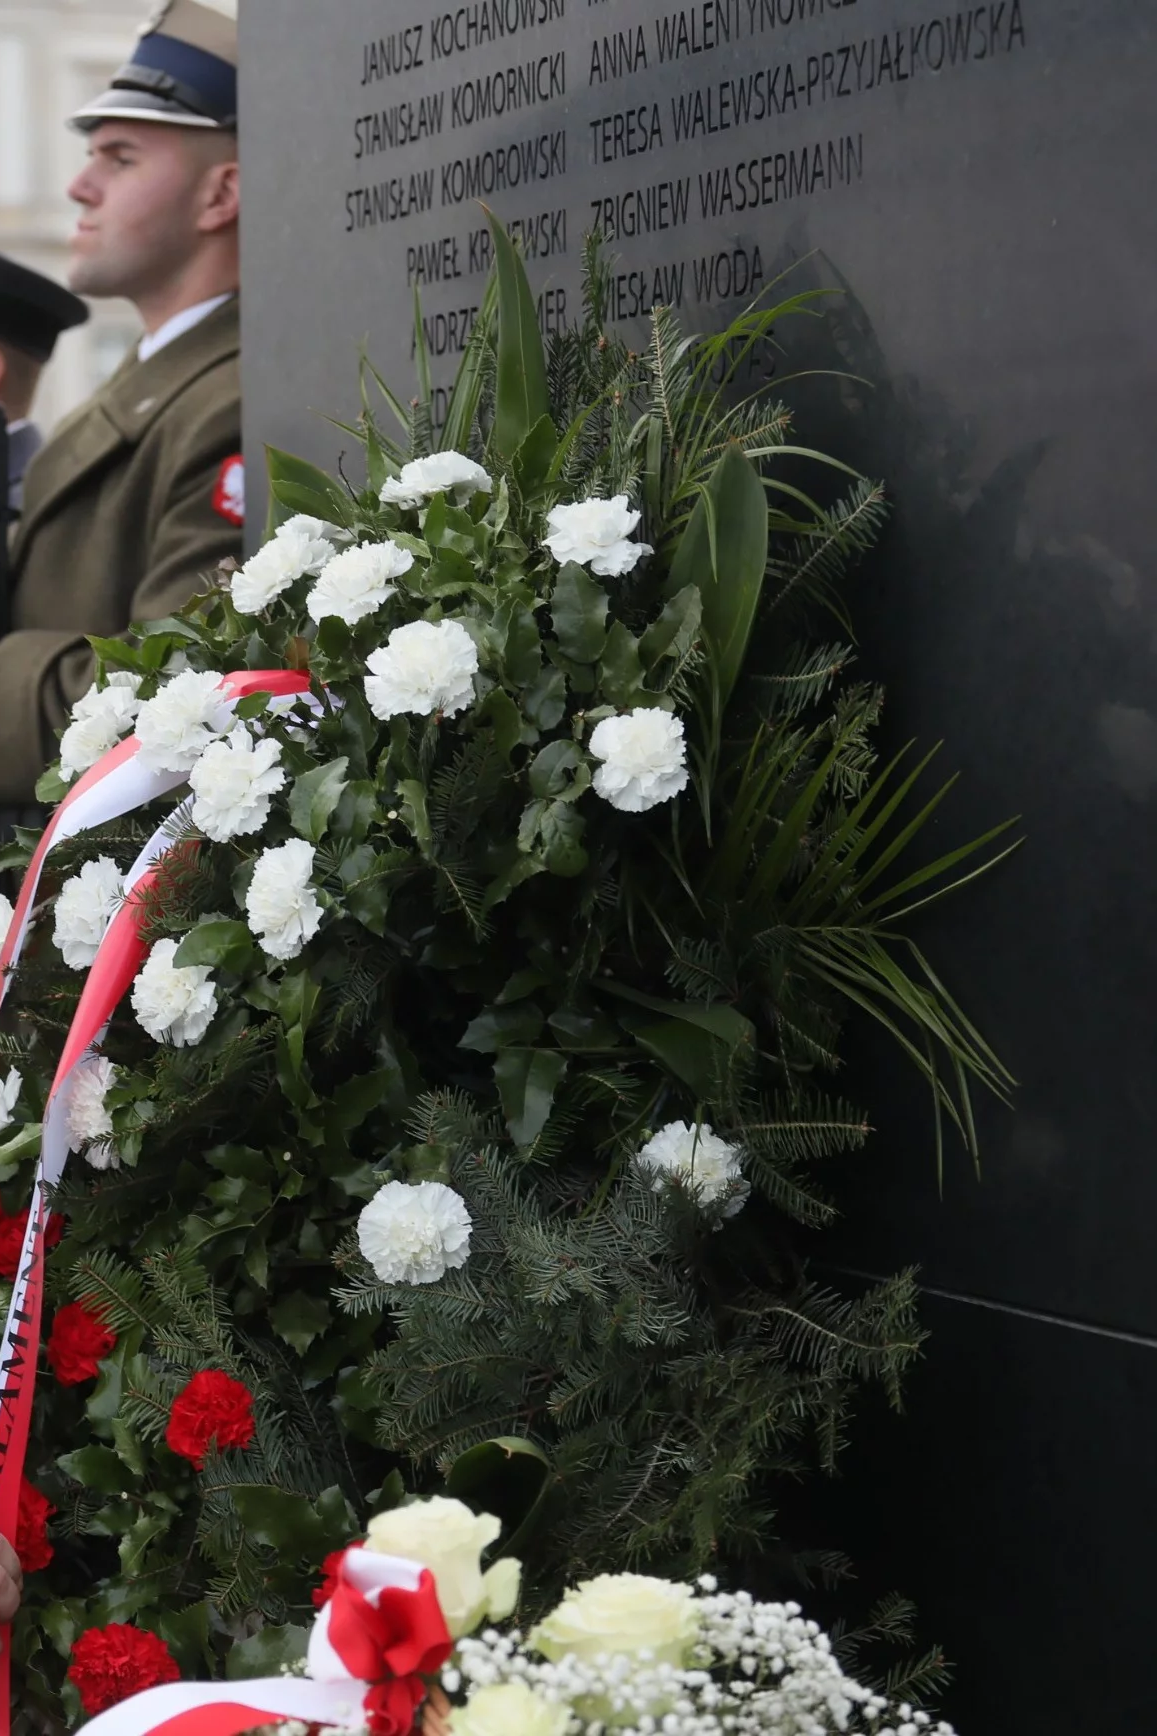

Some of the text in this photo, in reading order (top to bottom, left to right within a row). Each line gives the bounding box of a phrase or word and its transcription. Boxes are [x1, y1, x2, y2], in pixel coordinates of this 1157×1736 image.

[360, 24, 424, 86] JANUSZ
[588, 0, 857, 86] ANNA WALENTYNO
[589, 0, 1026, 165] TERESA WALEWSKA-PRZYJAŁKOWSKA
[354, 51, 566, 160] STANISŁAW KOMORNICKI
[345, 129, 567, 232] STANISŁAW KOMOROWSKI
[590, 132, 864, 244] ZBIGNIEW WASSERMANN
[406, 208, 568, 288] PAWEŁ KREWSKI
[692, 245, 766, 303] WODA
